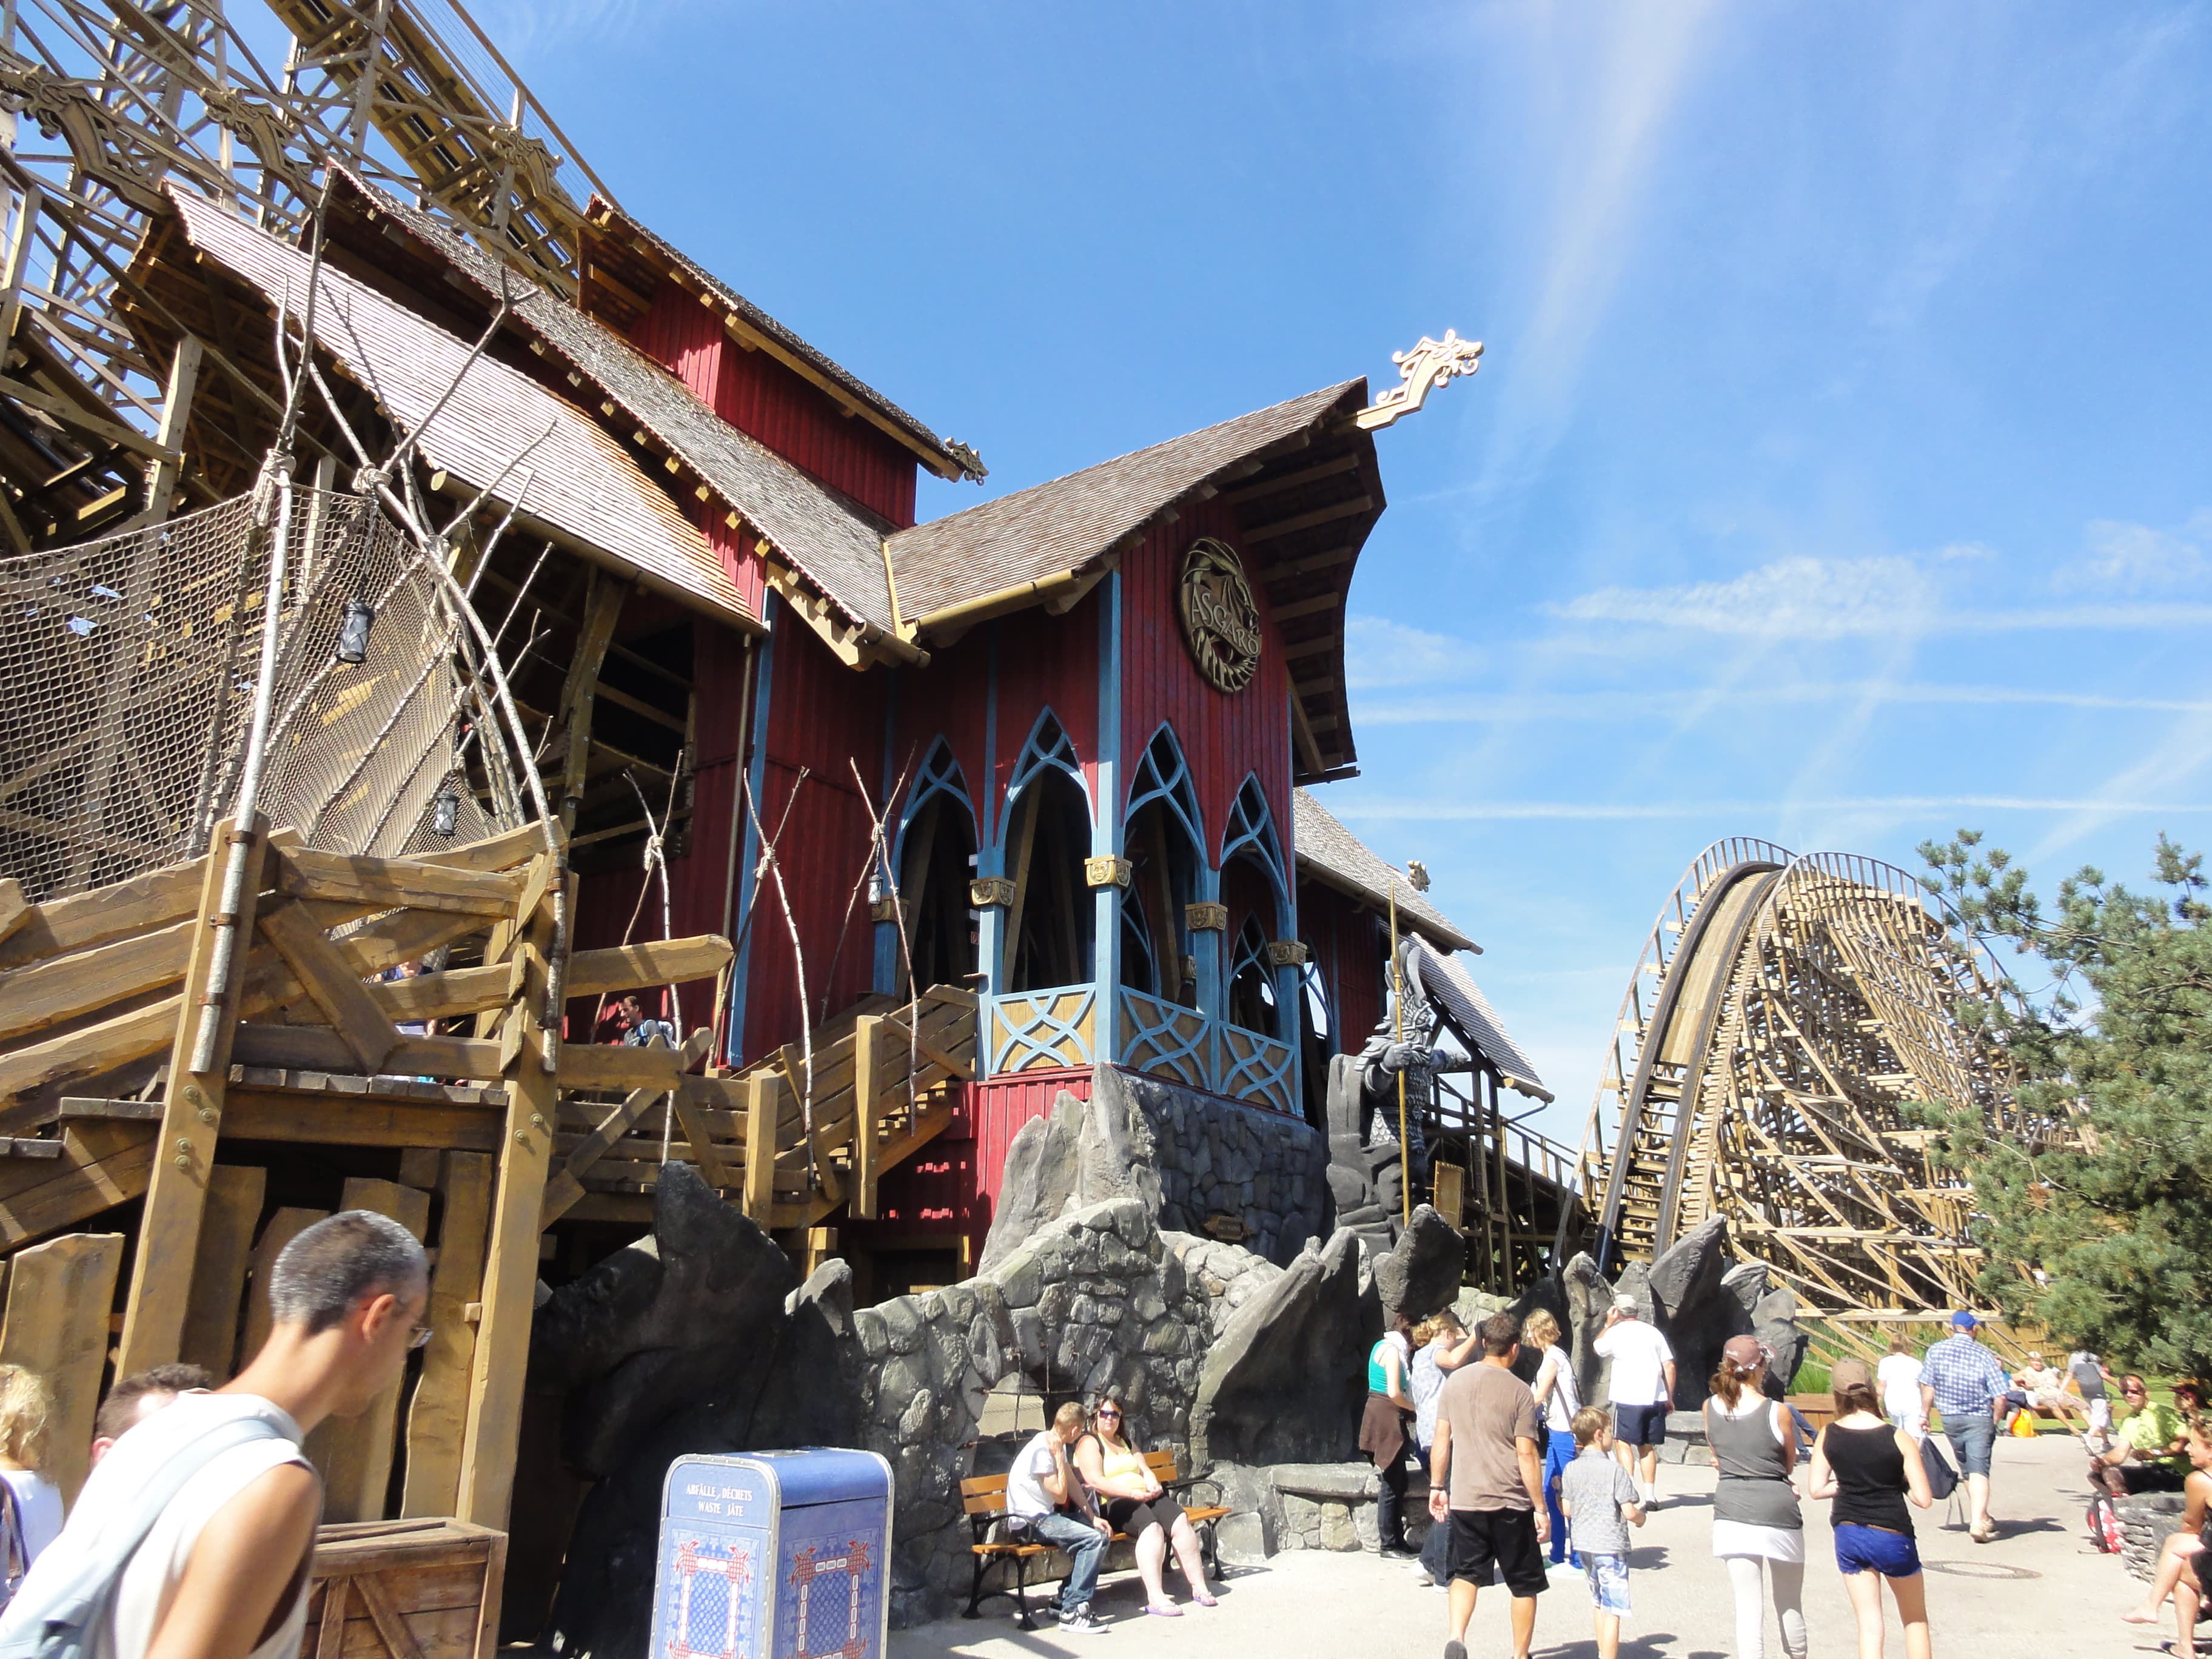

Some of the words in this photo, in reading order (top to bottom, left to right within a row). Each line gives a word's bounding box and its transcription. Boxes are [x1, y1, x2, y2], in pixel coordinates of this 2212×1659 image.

[1190, 585, 1259, 655] ASGARD
[722, 1486, 752, 1501] DÉCHETS
[699, 1501, 721, 1513] WASTE
